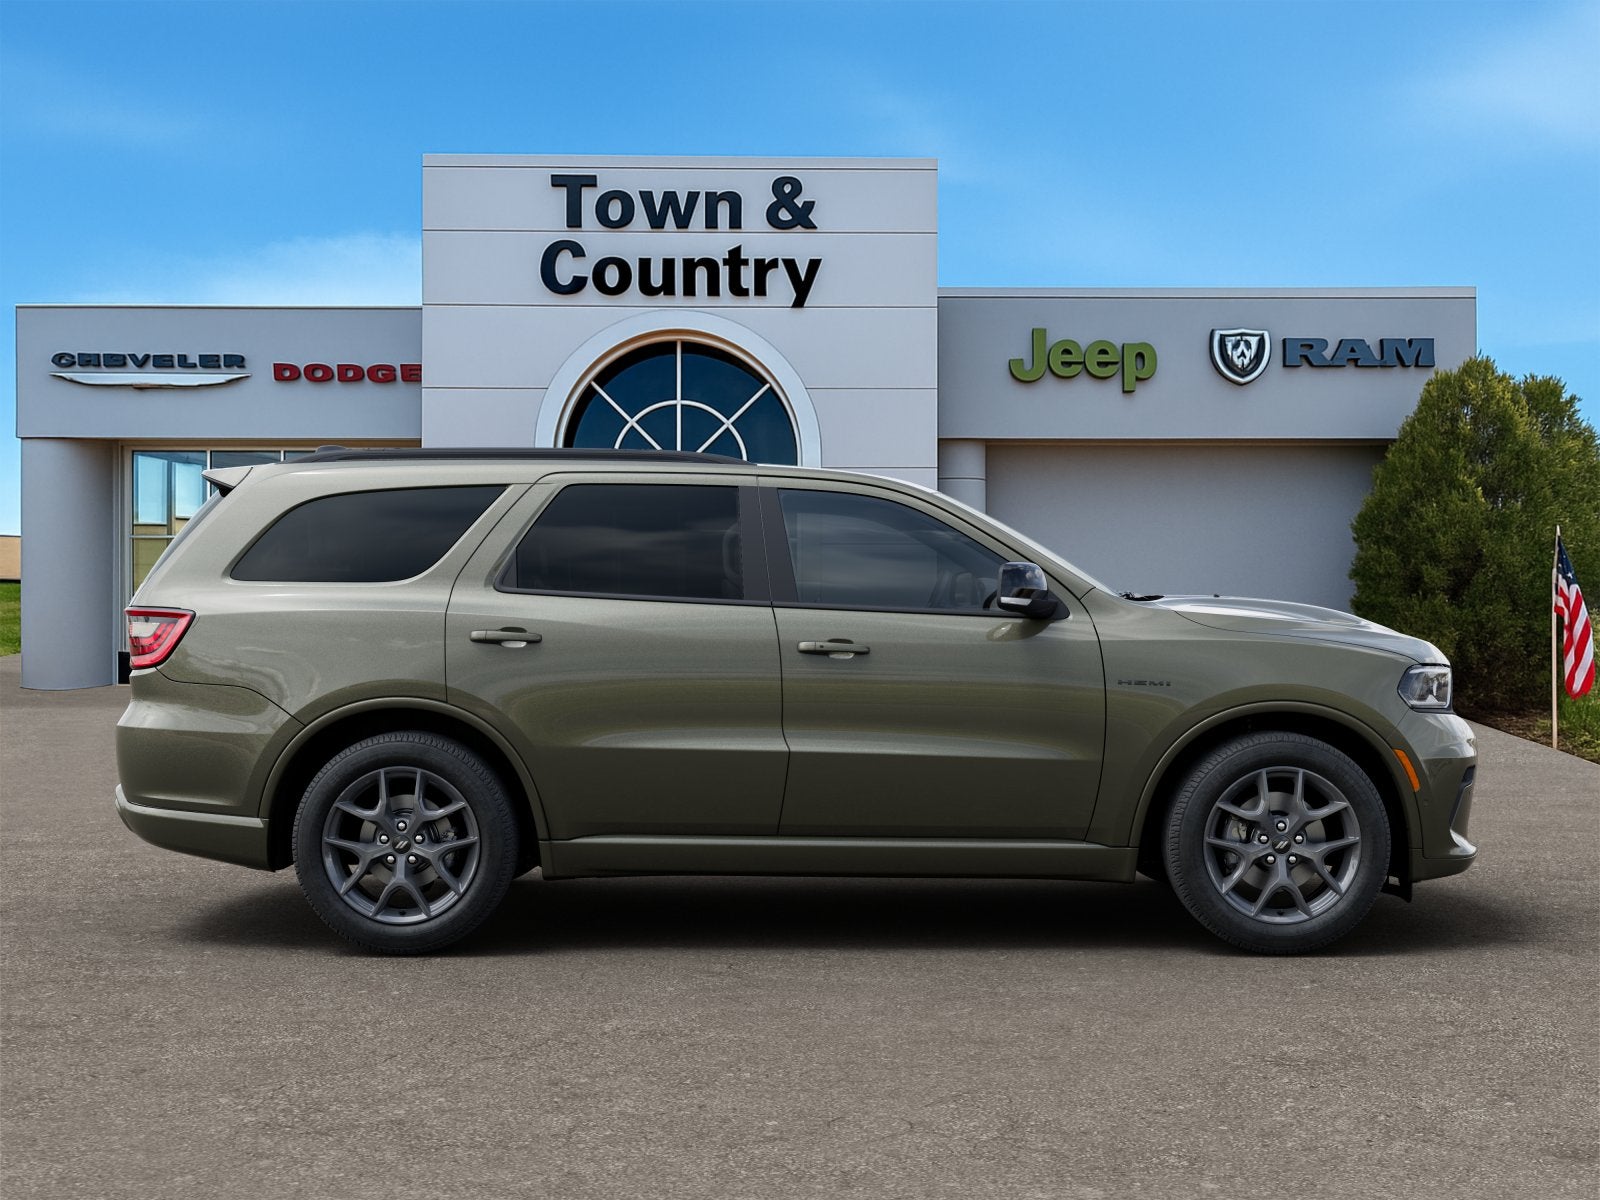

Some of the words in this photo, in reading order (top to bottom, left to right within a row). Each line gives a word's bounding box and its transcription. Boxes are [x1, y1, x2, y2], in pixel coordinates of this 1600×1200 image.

[550, 174, 743, 230] Town
[766, 176, 818, 230] &
[539, 239, 823, 308] Country
[273, 362, 422, 383] DODGE
[1008, 327, 1158, 394] Jeep
[1282, 337, 1436, 368] RAM
[1117, 679, 1172, 687] HEMI
